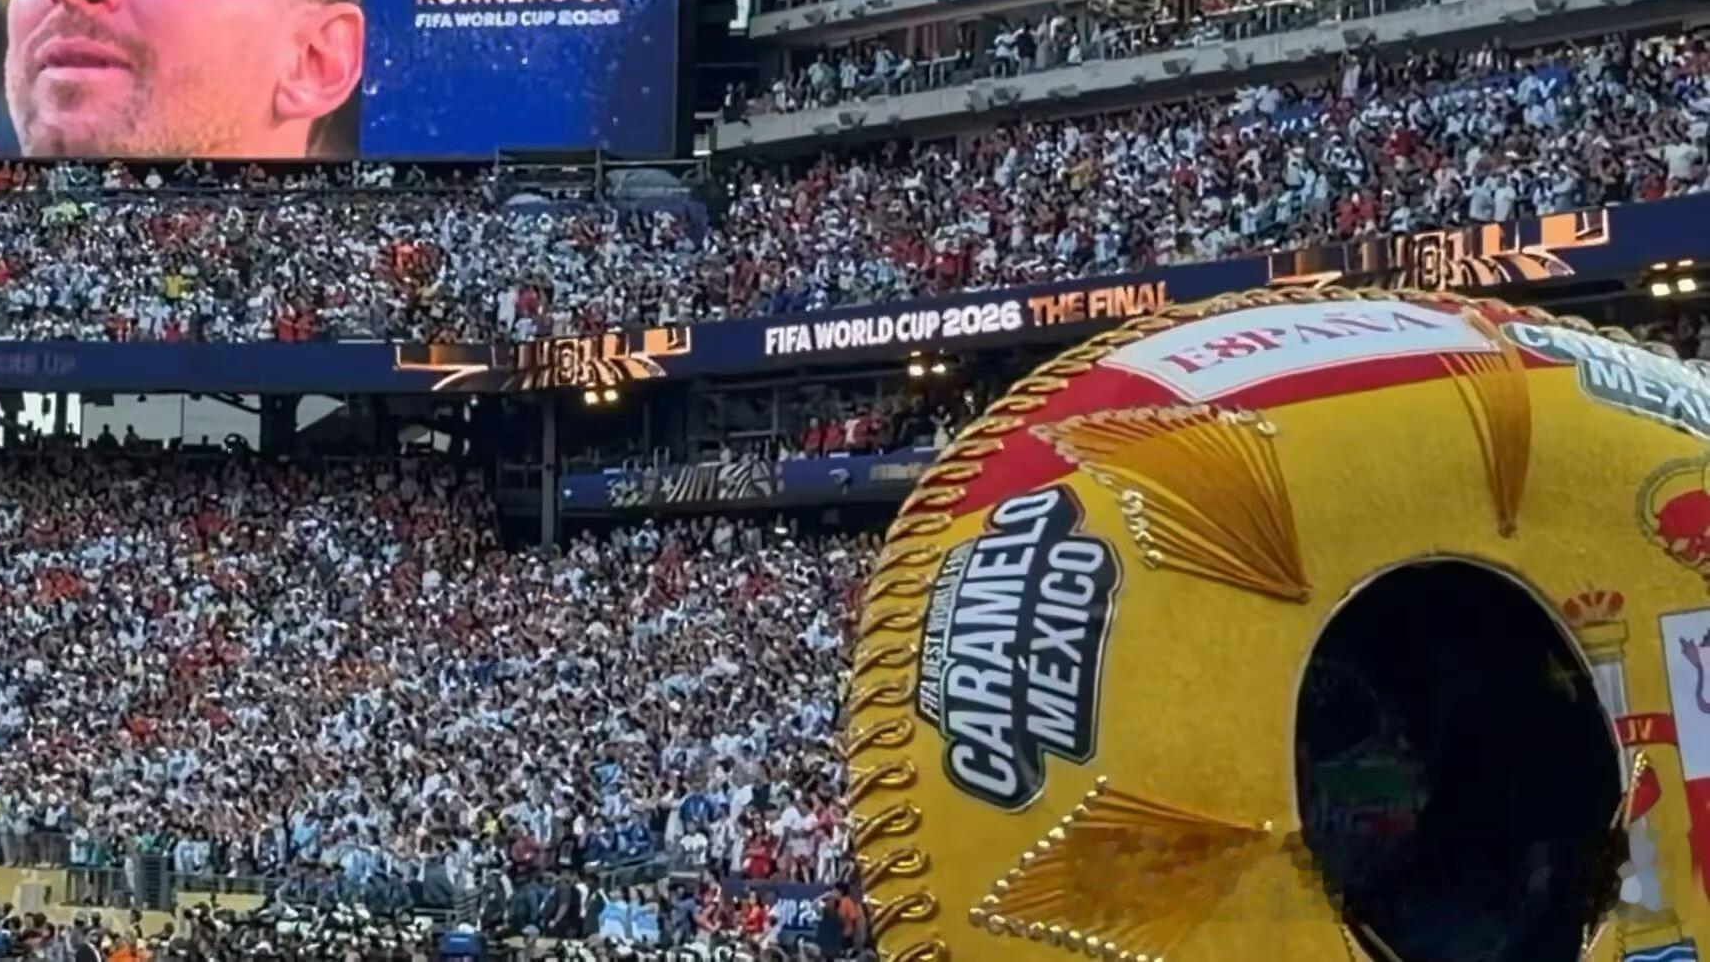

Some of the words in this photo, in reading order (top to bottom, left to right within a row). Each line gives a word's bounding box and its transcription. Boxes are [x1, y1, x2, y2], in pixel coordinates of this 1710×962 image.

[414, 12, 453, 29] FIFA
[454, 10, 519, 28] WORLD
[520, 9, 556, 27] CUP
[557, 8, 621, 26] 2026
[764, 324, 813, 356] FIFA
[813, 315, 893, 350] WORLD
[895, 311, 940, 343] CUP
[942, 300, 1023, 338] 2026
[1027, 292, 1087, 327] THE
[1161, 308, 1442, 374] ESPAÑA
[921, 635, 943, 677] BEST
[946, 488, 1060, 796] CARAMELO
[1018, 540, 1105, 750] MÉXICO
